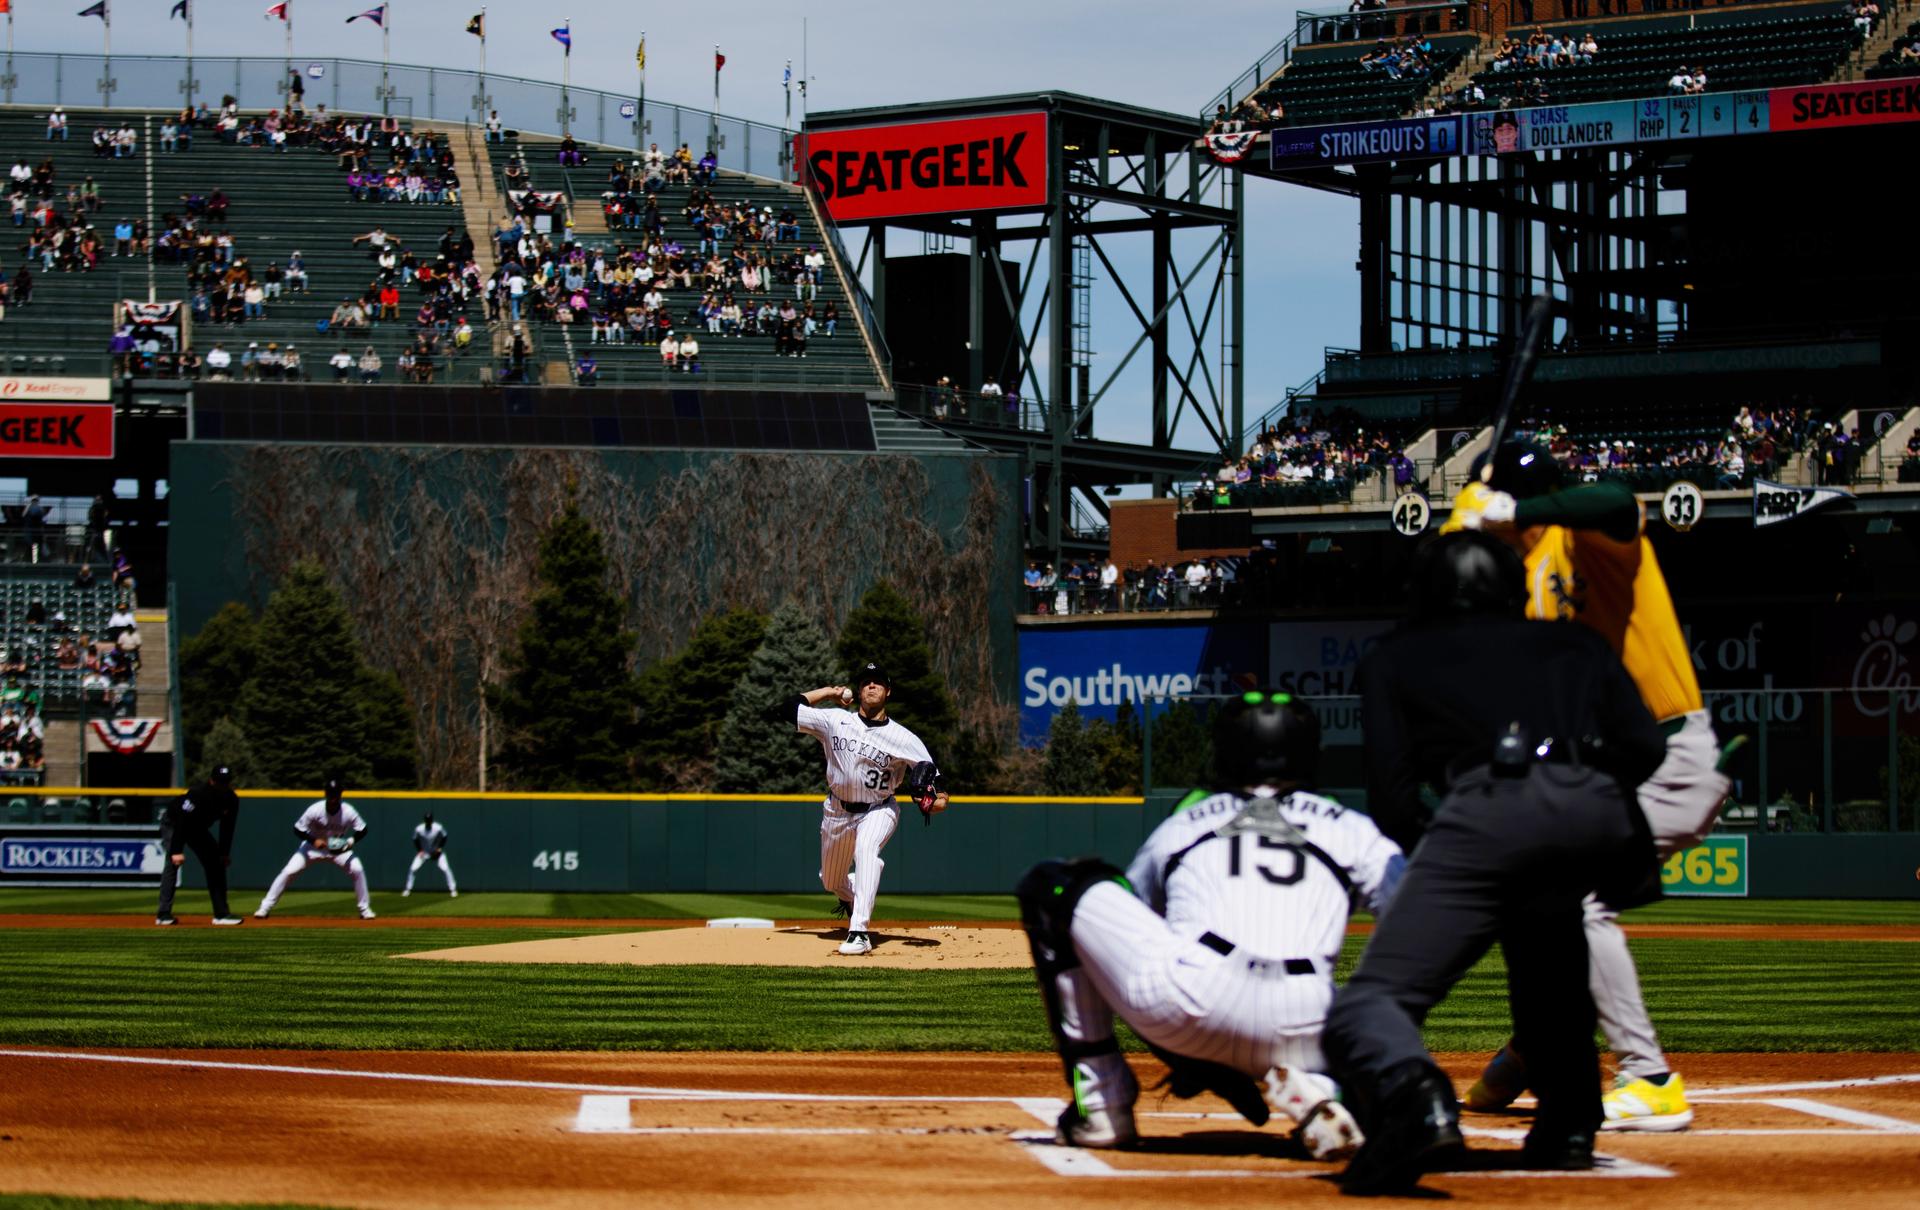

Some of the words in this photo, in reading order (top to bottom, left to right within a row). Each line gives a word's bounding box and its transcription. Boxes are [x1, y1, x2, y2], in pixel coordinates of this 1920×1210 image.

[1530, 107, 1569, 128] CHASE
[1644, 101, 1660, 117] 32
[1713, 105, 1721, 121] 6
[1748, 106, 1760, 129] 4
[1530, 121, 1613, 146] DOLLANDER
[1639, 117, 1665, 140] RHP
[1679, 111, 1690, 134] 2
[1319, 125, 1424, 159] STRIKEOUTS
[1437, 127, 1448, 150] 0
[809, 130, 1028, 202] SEATGEEK
[1395, 503, 1422, 530] 42
[1670, 494, 1696, 523] 33
[1715, 620, 1765, 671] of
[1023, 662, 1229, 708] Southwest
[1279, 671, 1364, 696] SCHA
[831, 735, 893, 769] ROCKIES
[865, 769, 892, 790] 32
[532, 849, 579, 871] 415
[1230, 824, 1306, 885] 15
[1660, 846, 1740, 887] 365
